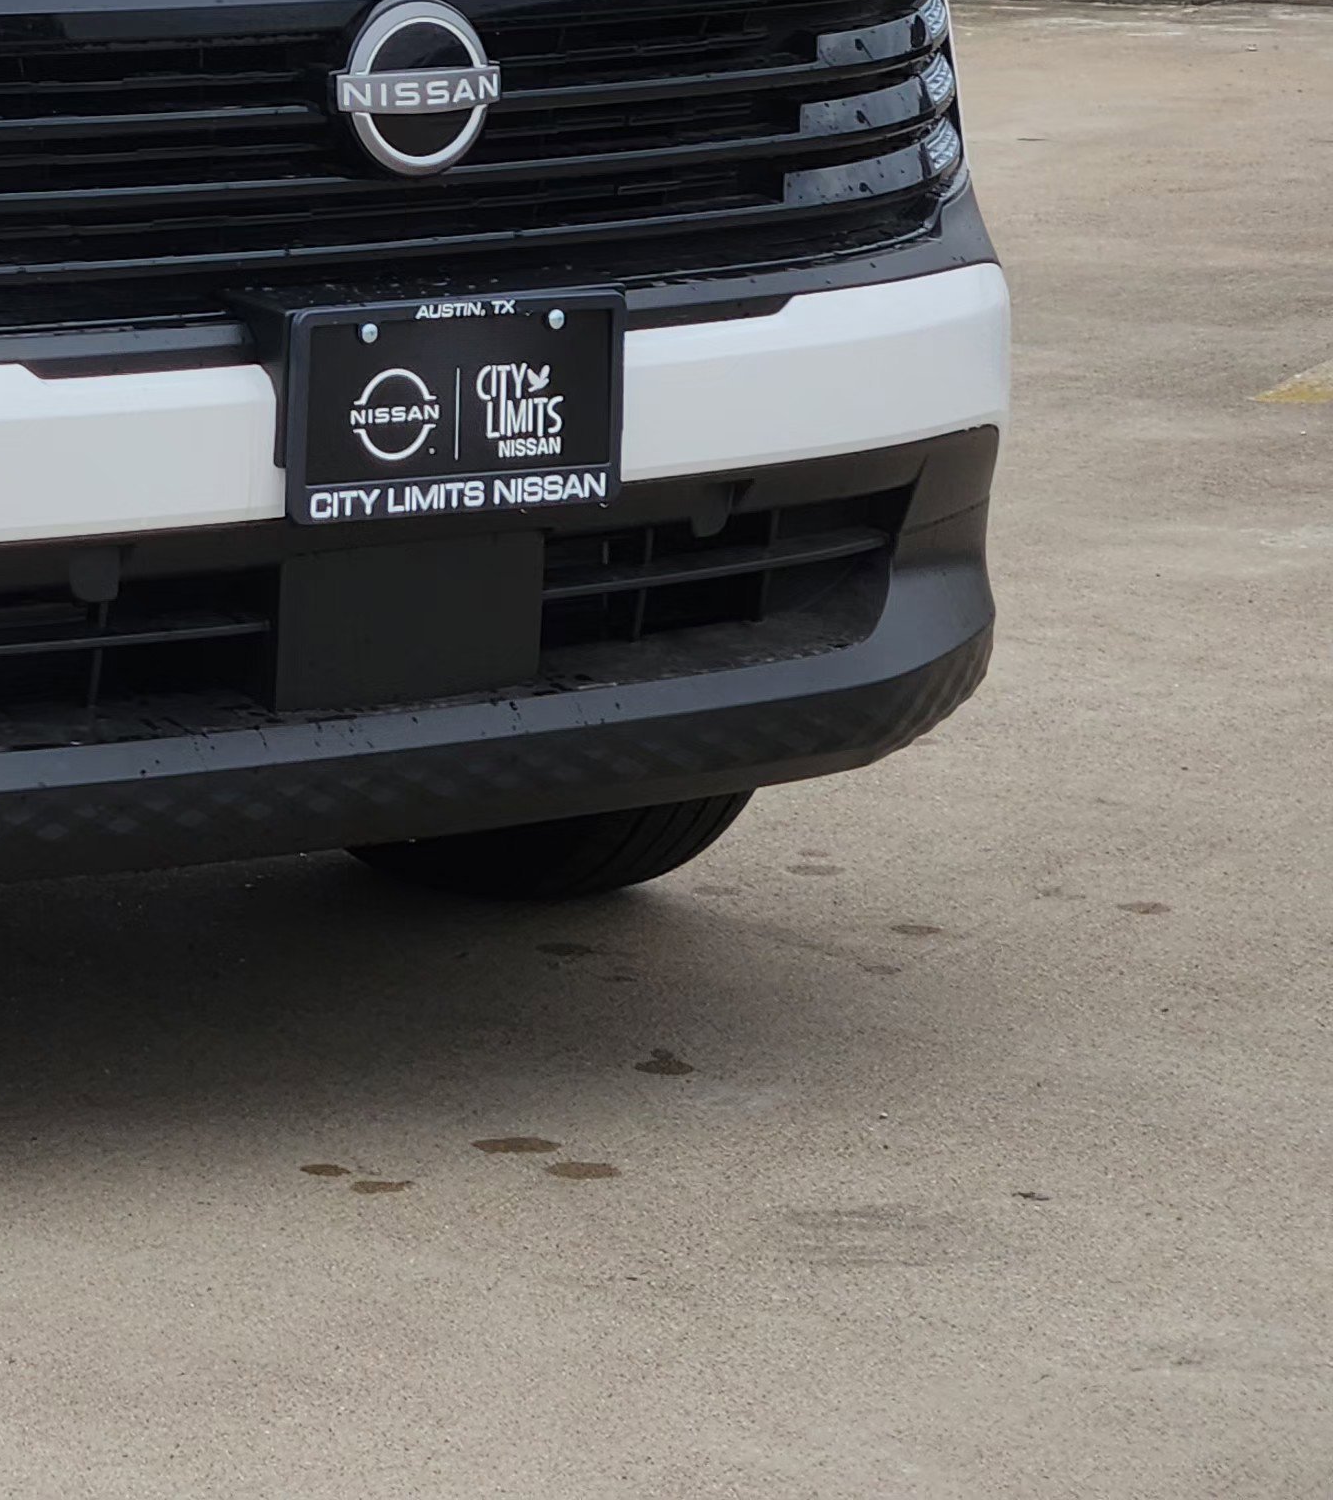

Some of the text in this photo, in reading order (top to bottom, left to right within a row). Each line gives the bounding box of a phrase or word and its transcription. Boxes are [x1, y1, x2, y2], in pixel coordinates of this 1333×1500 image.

[342, 73, 498, 106] NISSAN
[491, 299, 515, 315] TX
[475, 362, 528, 401] CITY
[349, 403, 440, 426] NISSAN
[486, 395, 564, 439] LIMITS
[498, 436, 561, 458] NISSAN
[309, 472, 607, 519] CITY LIMITS NISSAN
